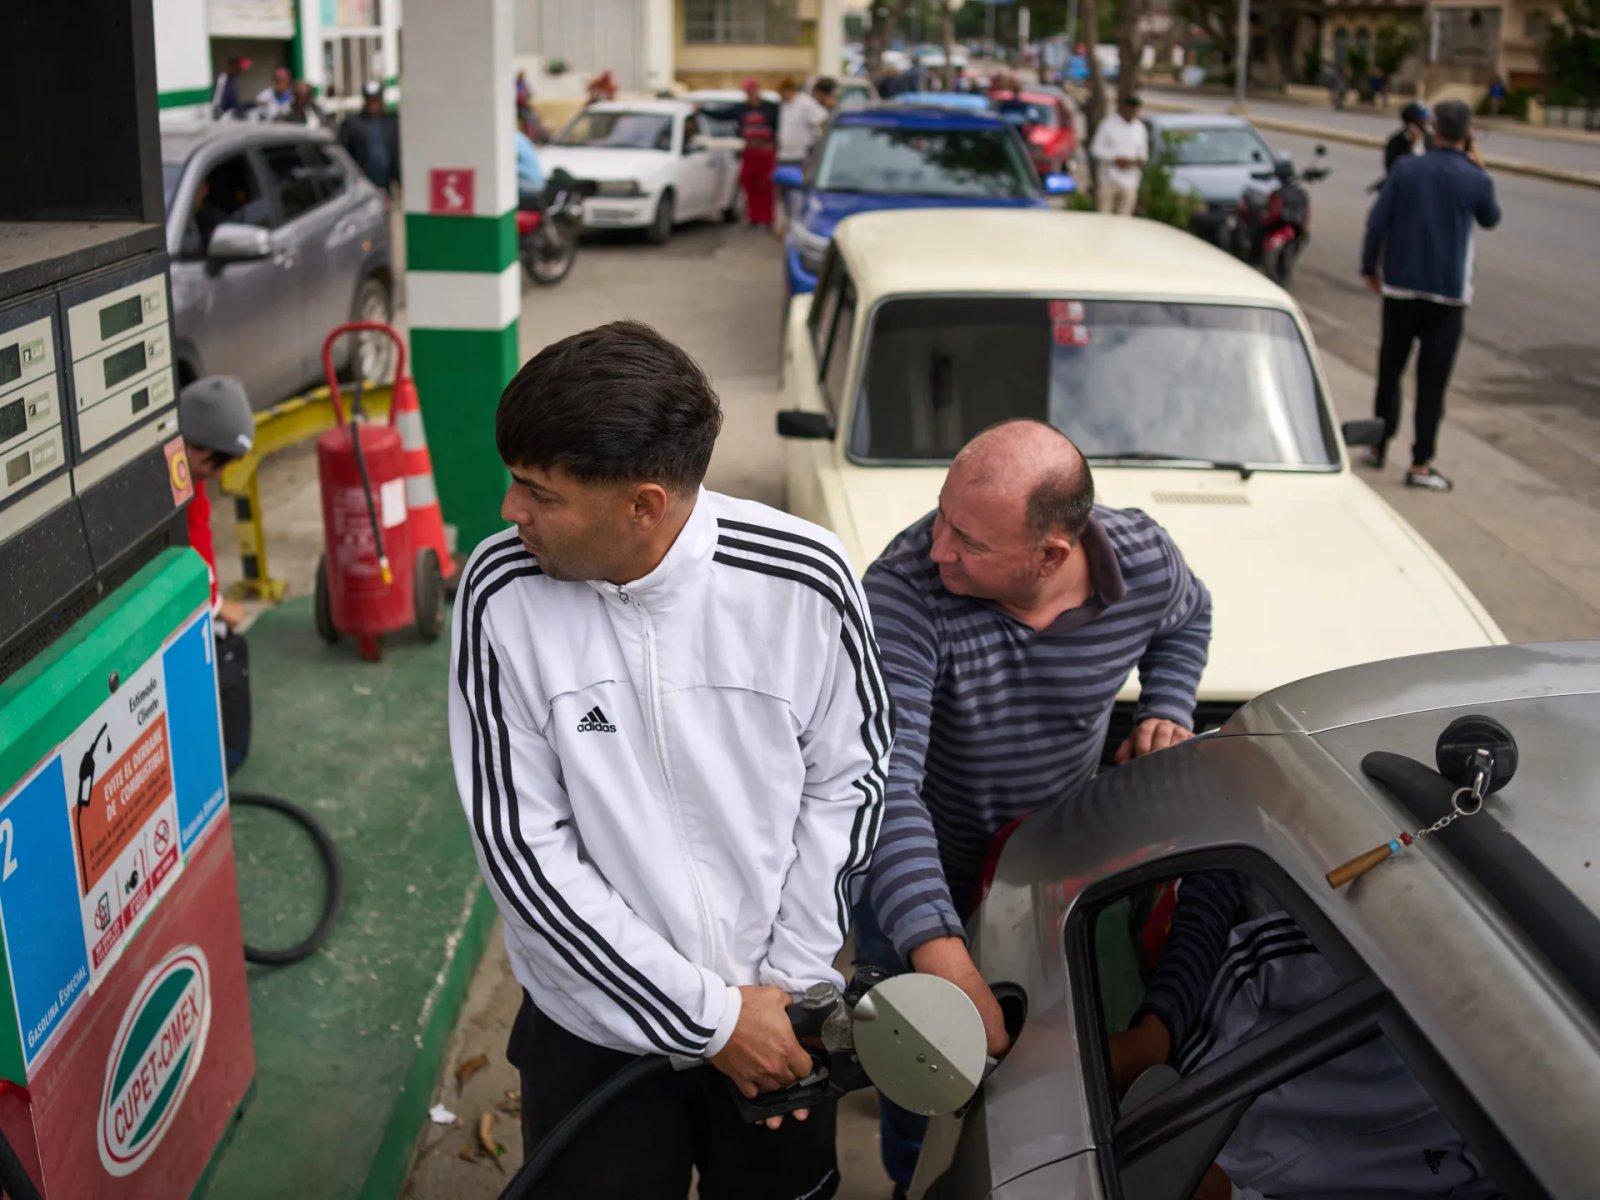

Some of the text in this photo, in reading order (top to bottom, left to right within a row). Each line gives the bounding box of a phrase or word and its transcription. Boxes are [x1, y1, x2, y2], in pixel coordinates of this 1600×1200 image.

[202, 619, 211, 665] 1
[137, 698, 158, 726] Cliente
[577, 721, 617, 733] adidas
[104, 766, 124, 802] EVITE
[124, 760, 133, 780] EL
[106, 798, 117, 822] DE
[0, 817, 18, 883] 2
[28, 1000, 60, 1049] GASOLINA
[113, 988, 200, 1145] CUPET-CIMEX
